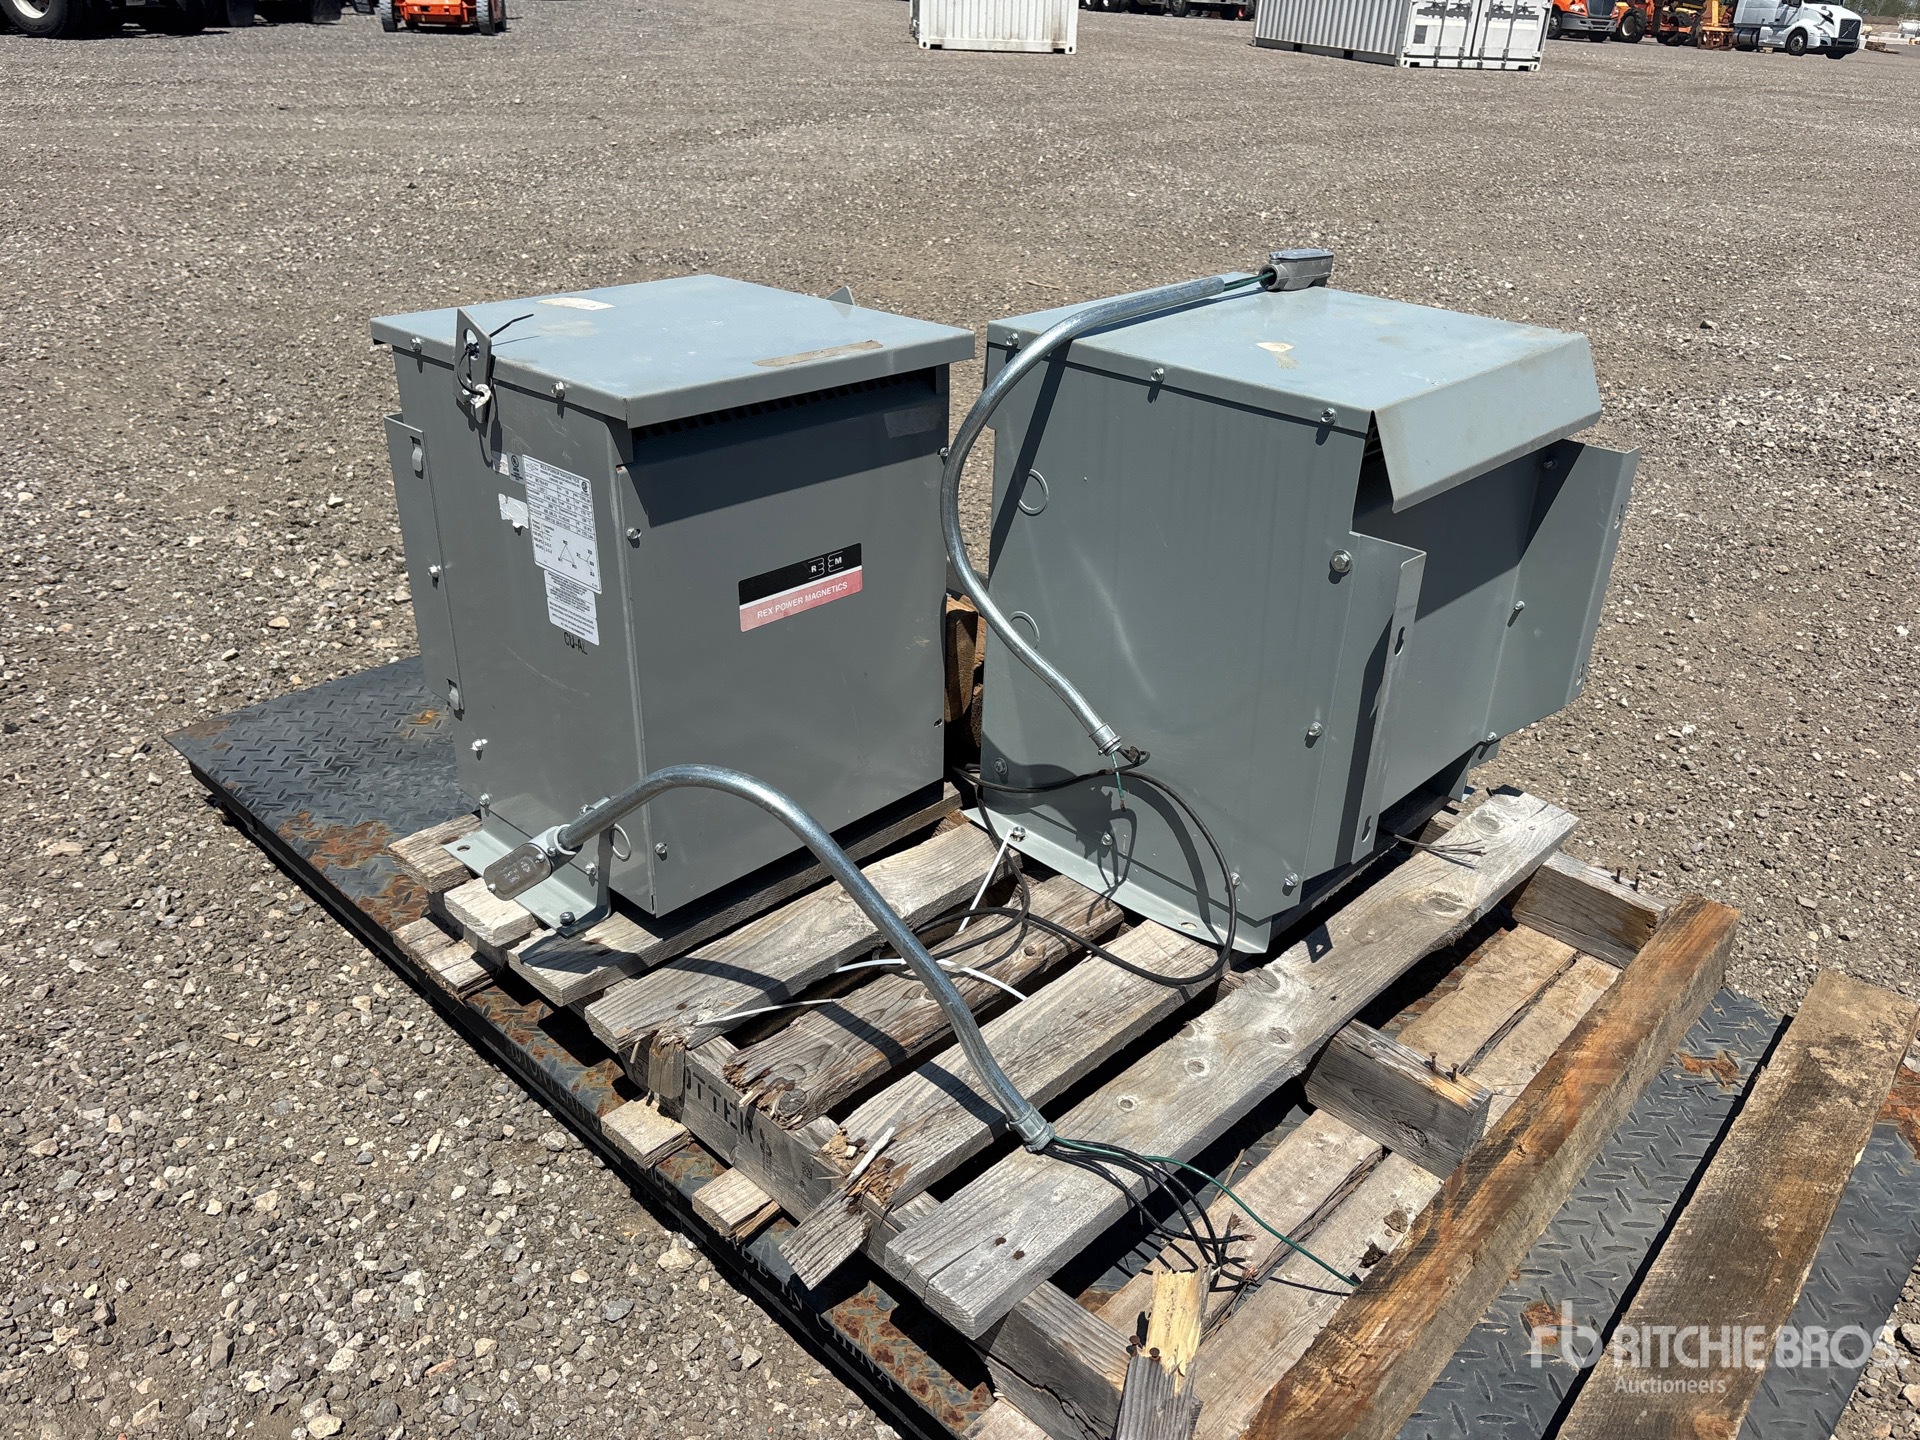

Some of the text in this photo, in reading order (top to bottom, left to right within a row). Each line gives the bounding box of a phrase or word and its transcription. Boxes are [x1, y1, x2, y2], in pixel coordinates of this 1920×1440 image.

[757, 582, 848, 619] REX POWER MAGNETICS
[564, 632, 588, 656] CU-AL
[780, 1281, 803, 1312] IN
[815, 1312, 896, 1393] CHINA
